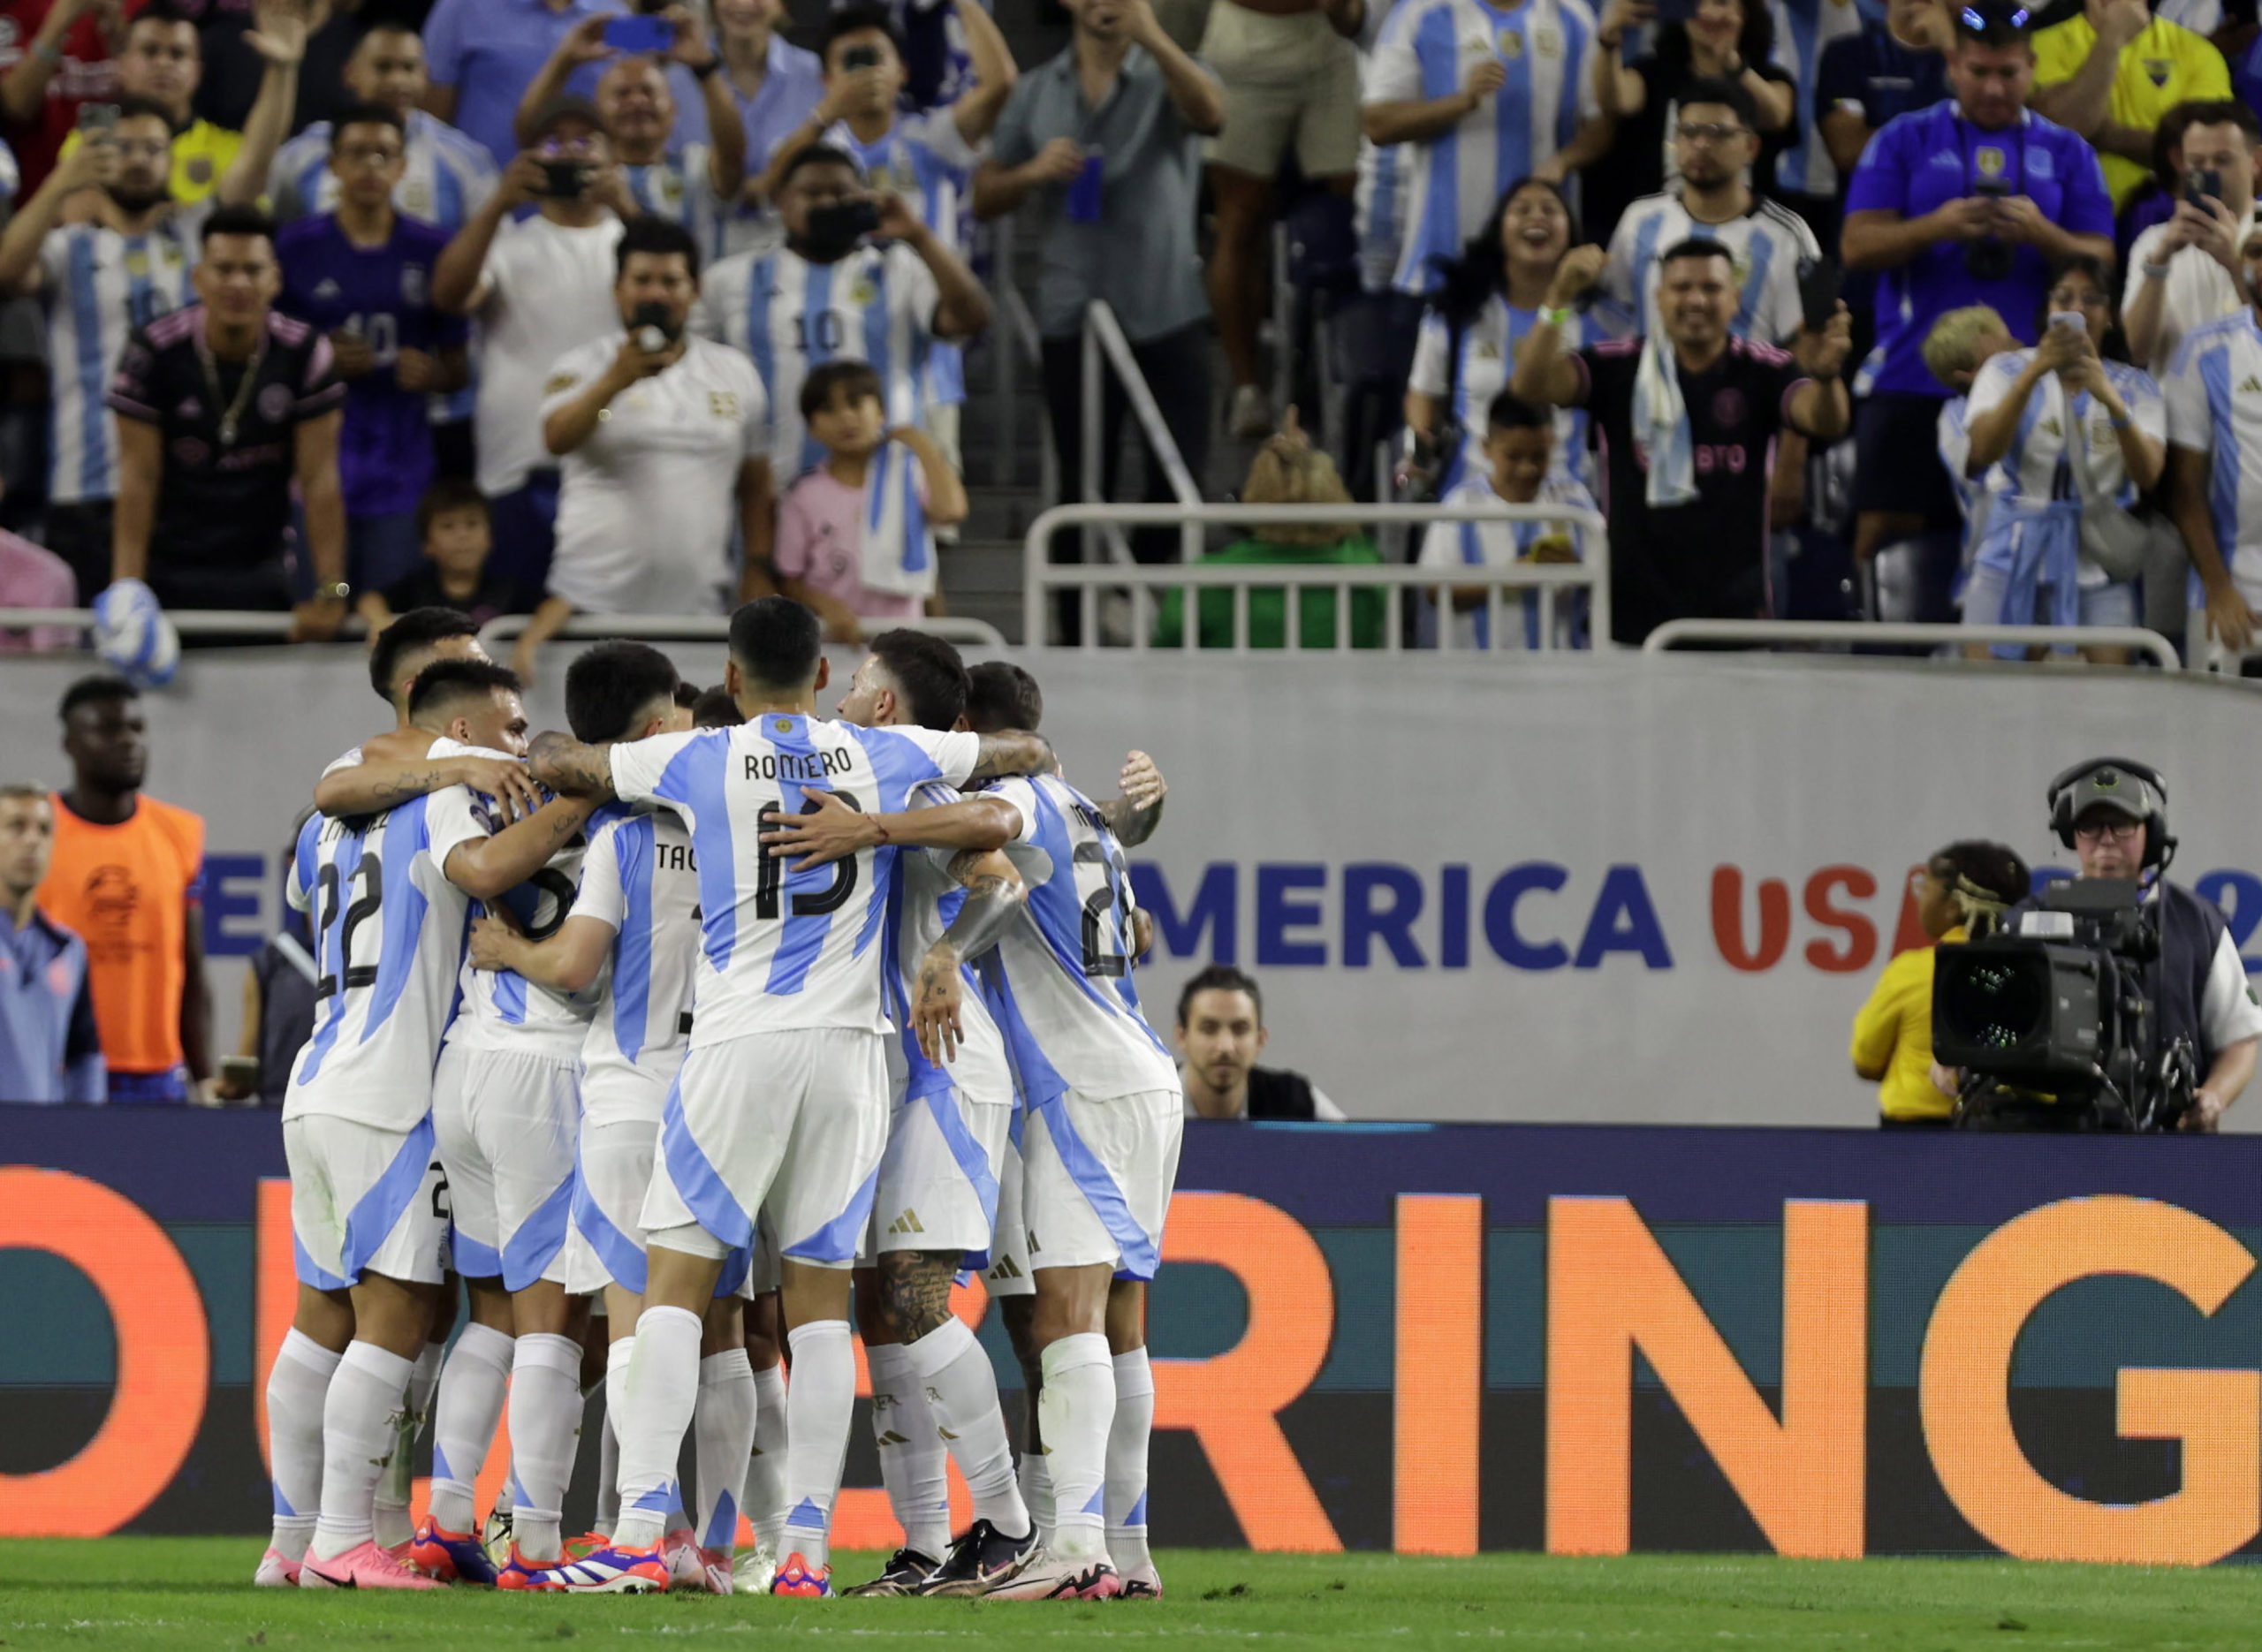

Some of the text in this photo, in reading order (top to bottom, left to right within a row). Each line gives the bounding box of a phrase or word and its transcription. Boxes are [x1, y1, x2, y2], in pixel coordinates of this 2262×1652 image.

[792, 308, 845, 353] 10
[744, 746, 853, 780] ROMERO
[315, 851, 383, 1002] 22
[1127, 860, 1674, 971] MERICA
[725, 1184, 2262, 1566] RING
